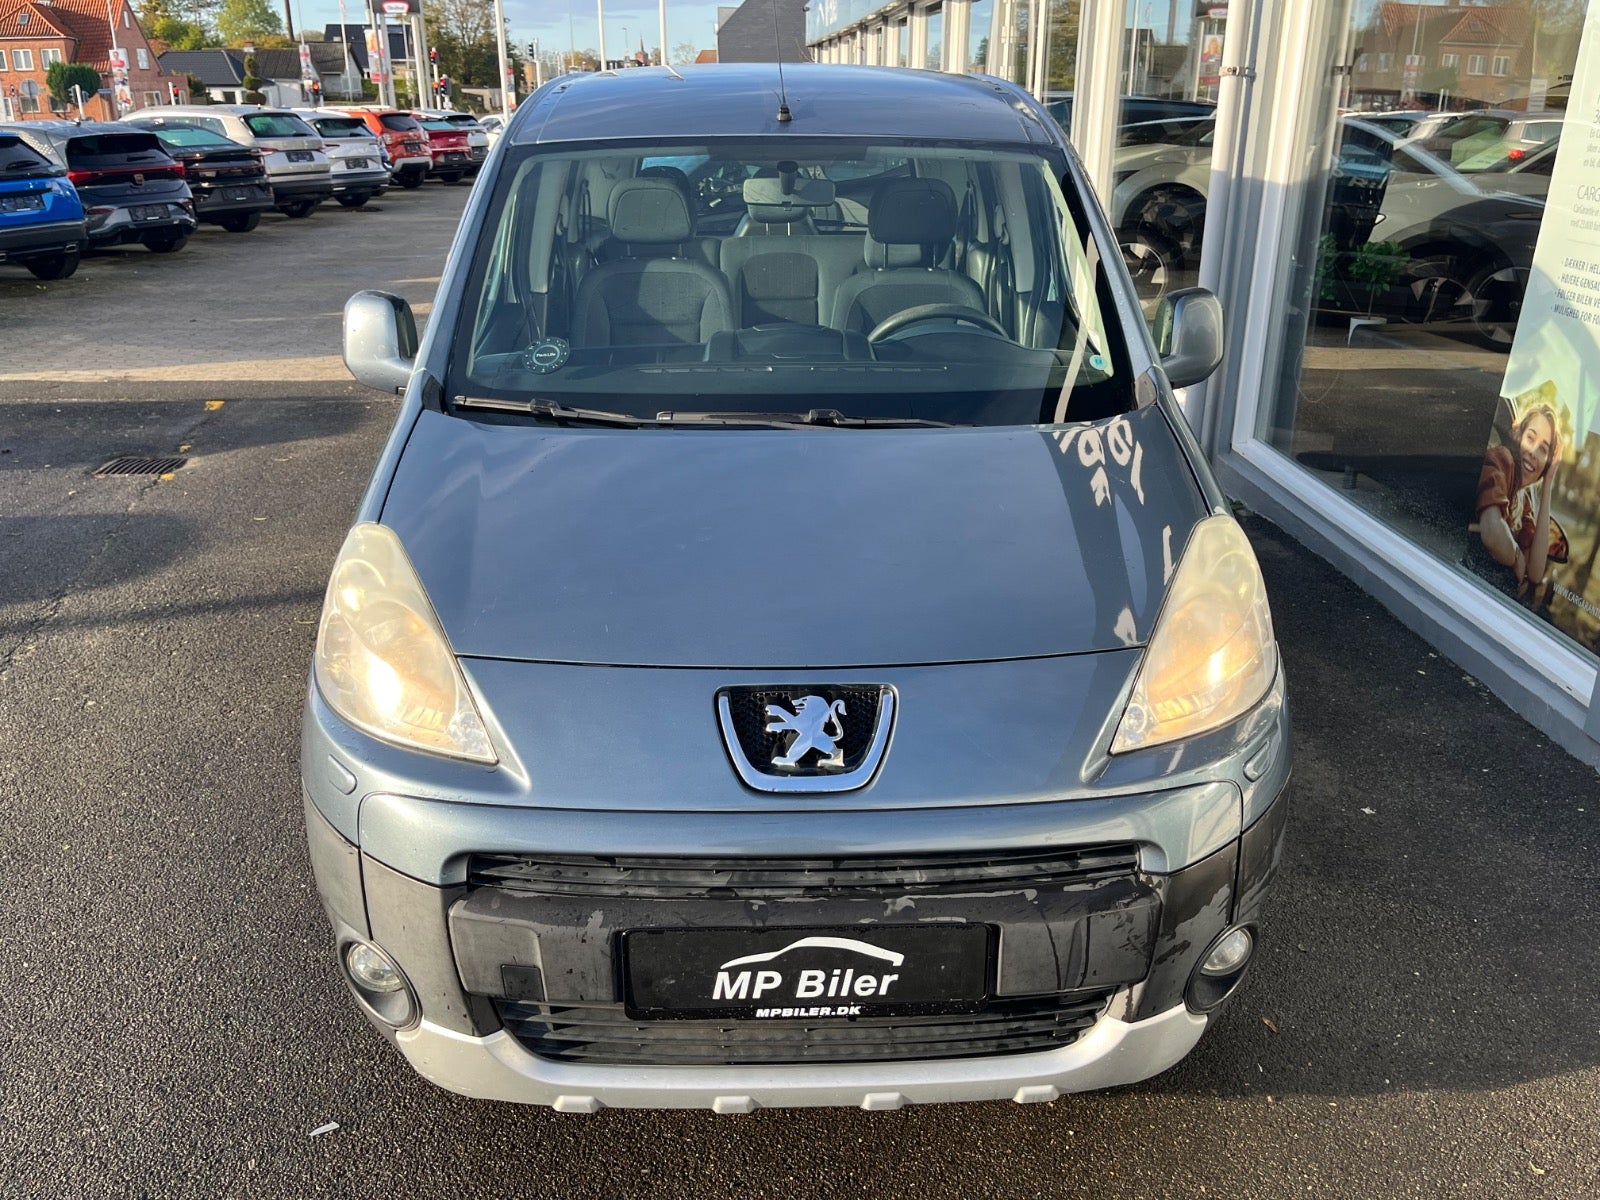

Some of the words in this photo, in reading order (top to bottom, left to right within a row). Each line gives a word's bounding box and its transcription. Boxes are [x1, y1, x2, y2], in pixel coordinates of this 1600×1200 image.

[712, 971, 782, 1000] MP
[795, 968, 899, 998] Biler
[756, 1006, 861, 1018] MPBILER.DK
